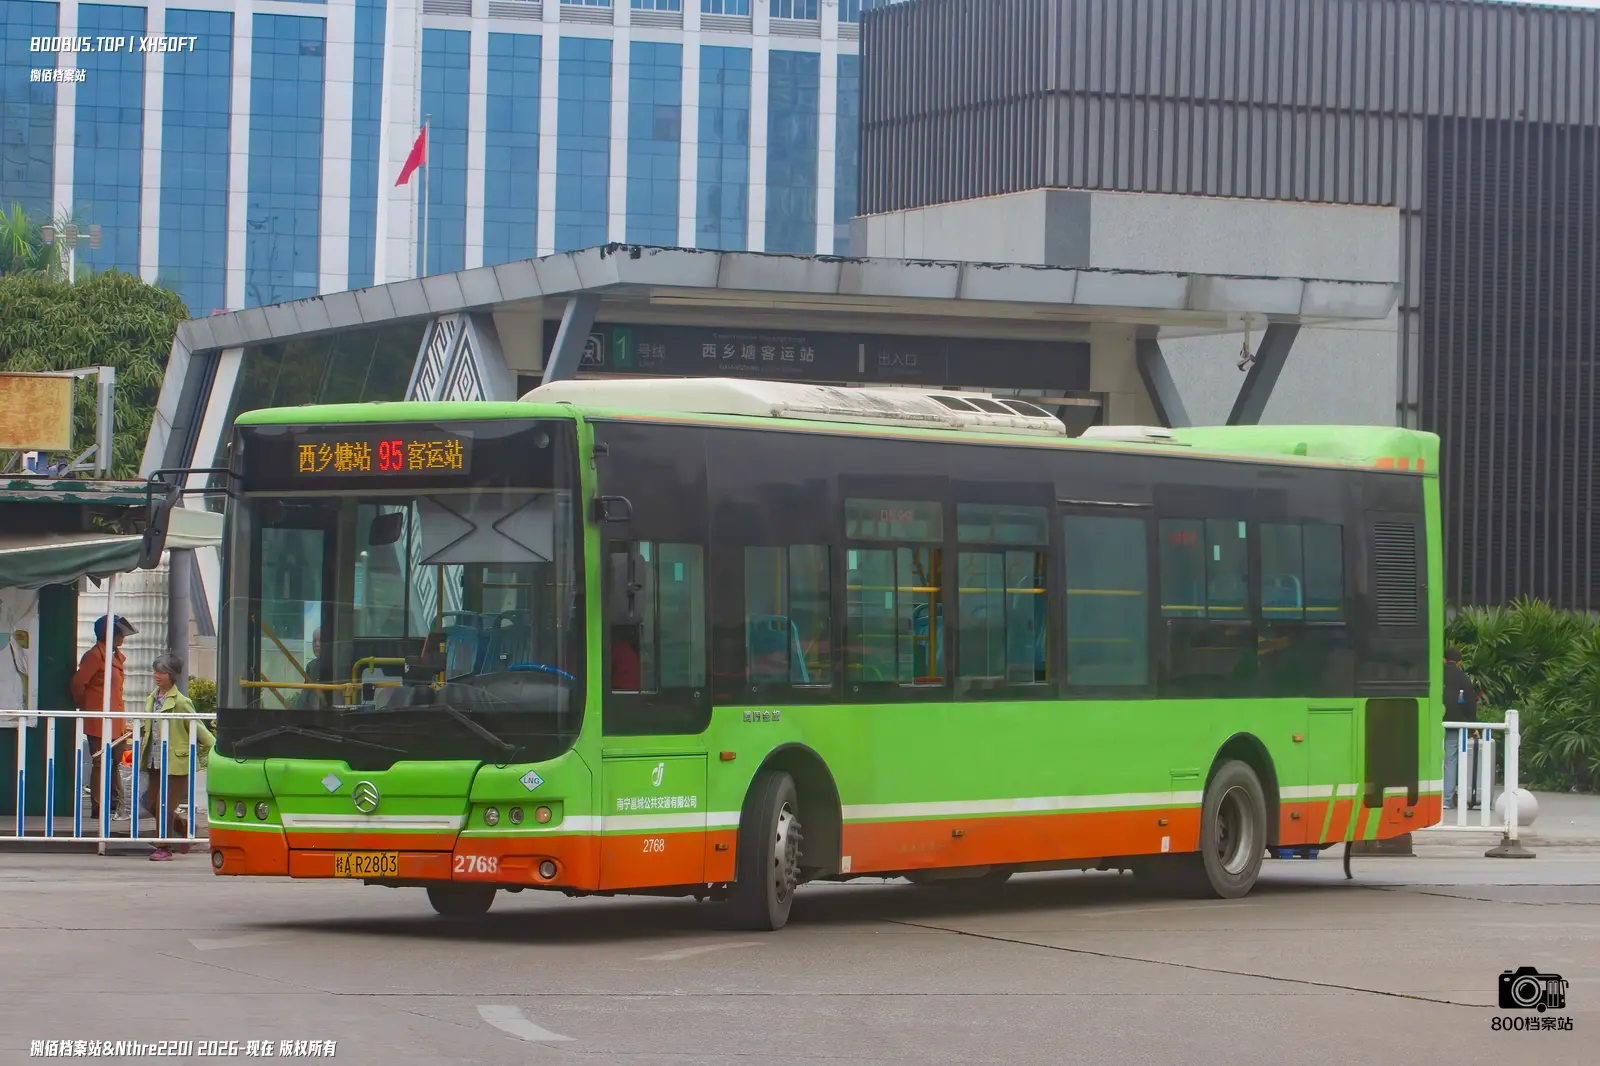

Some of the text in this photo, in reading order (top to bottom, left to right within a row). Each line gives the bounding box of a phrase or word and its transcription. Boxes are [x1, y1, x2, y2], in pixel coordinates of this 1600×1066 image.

[616, 335, 626, 359] 1
[702, 343, 815, 363] 西乡塘客运站
[879, 350, 917, 366] 出入口
[298, 439, 463, 472] 西乡塘站 95 客运站
[523, 776, 540, 785] LNG
[642, 838, 665, 853] 2768
[454, 855, 498, 873] 2768
